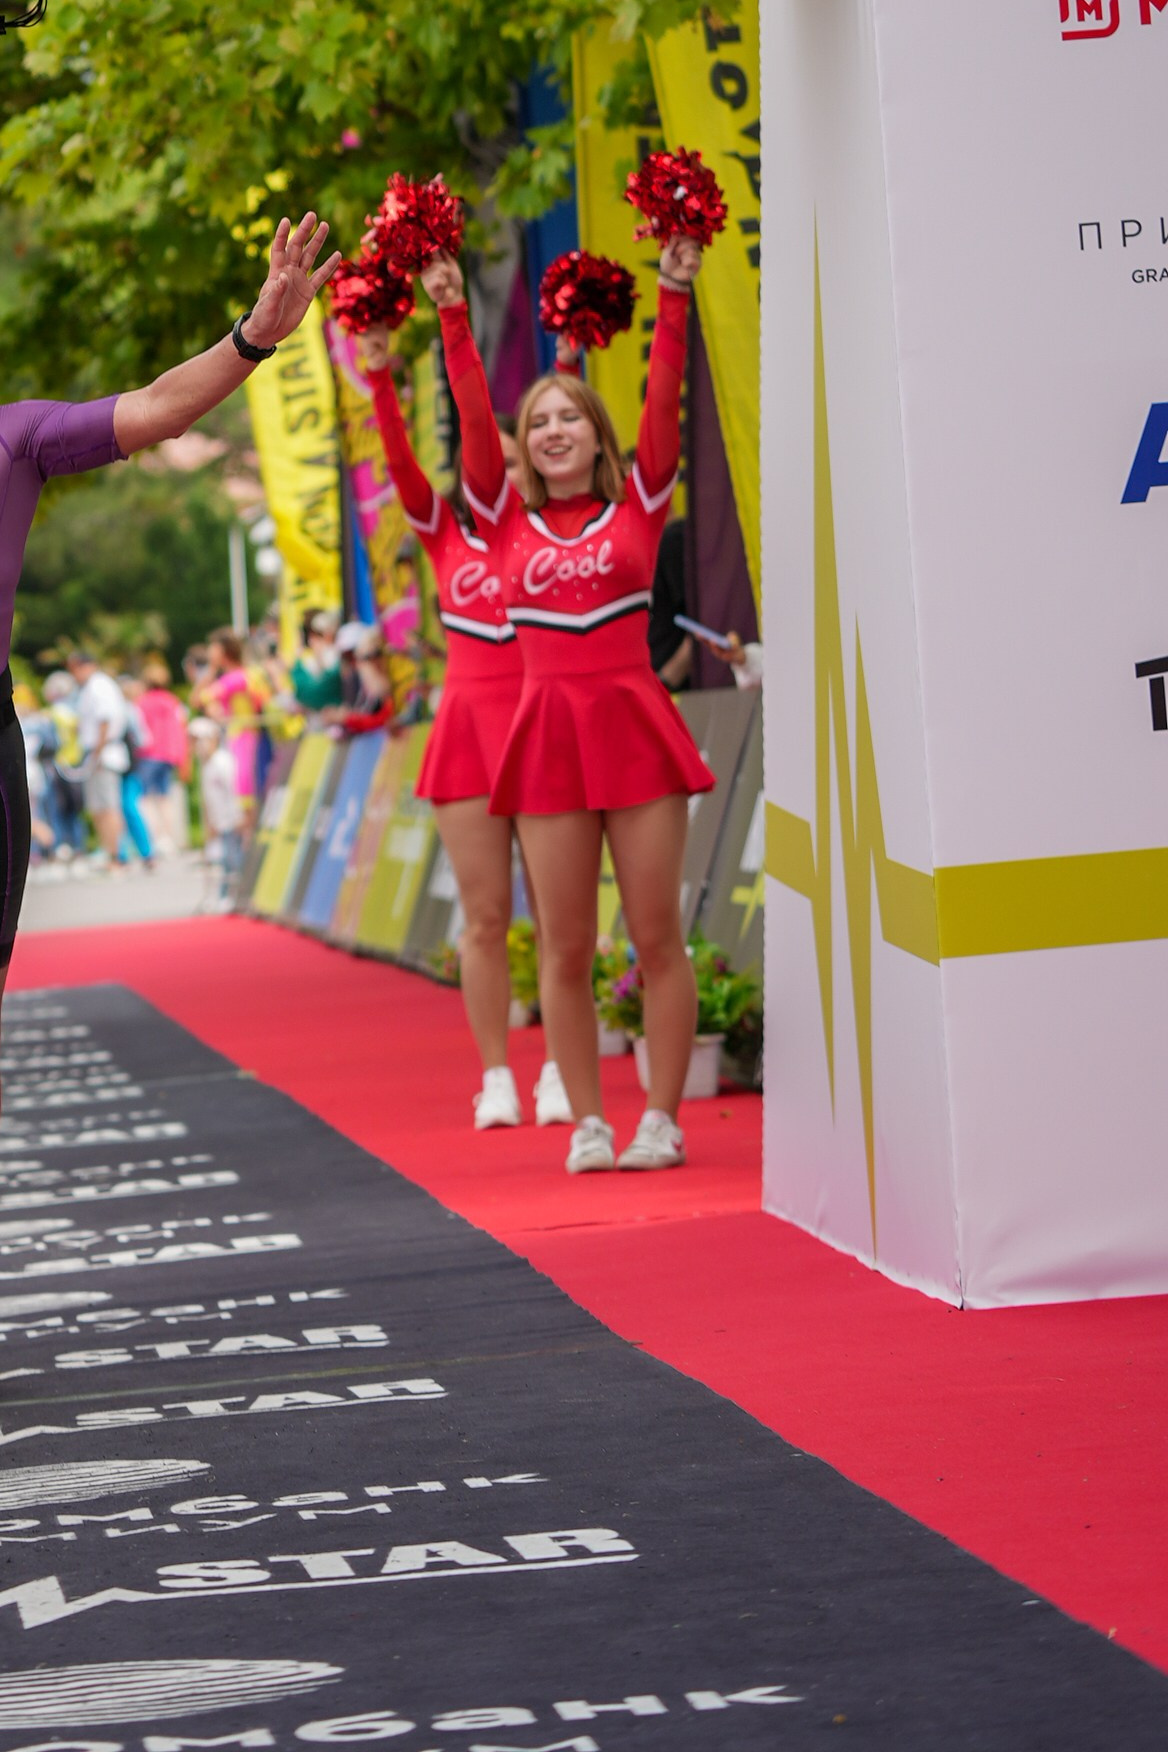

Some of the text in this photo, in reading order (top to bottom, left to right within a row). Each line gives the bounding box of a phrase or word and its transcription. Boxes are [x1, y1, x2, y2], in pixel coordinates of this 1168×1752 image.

[450, 560, 501, 607] Co
[523, 539, 614, 596] Cool
[54, 1324, 389, 1369] STAR
[75, 1378, 446, 1426] STAR
[156, 1527, 636, 1590] STAR
